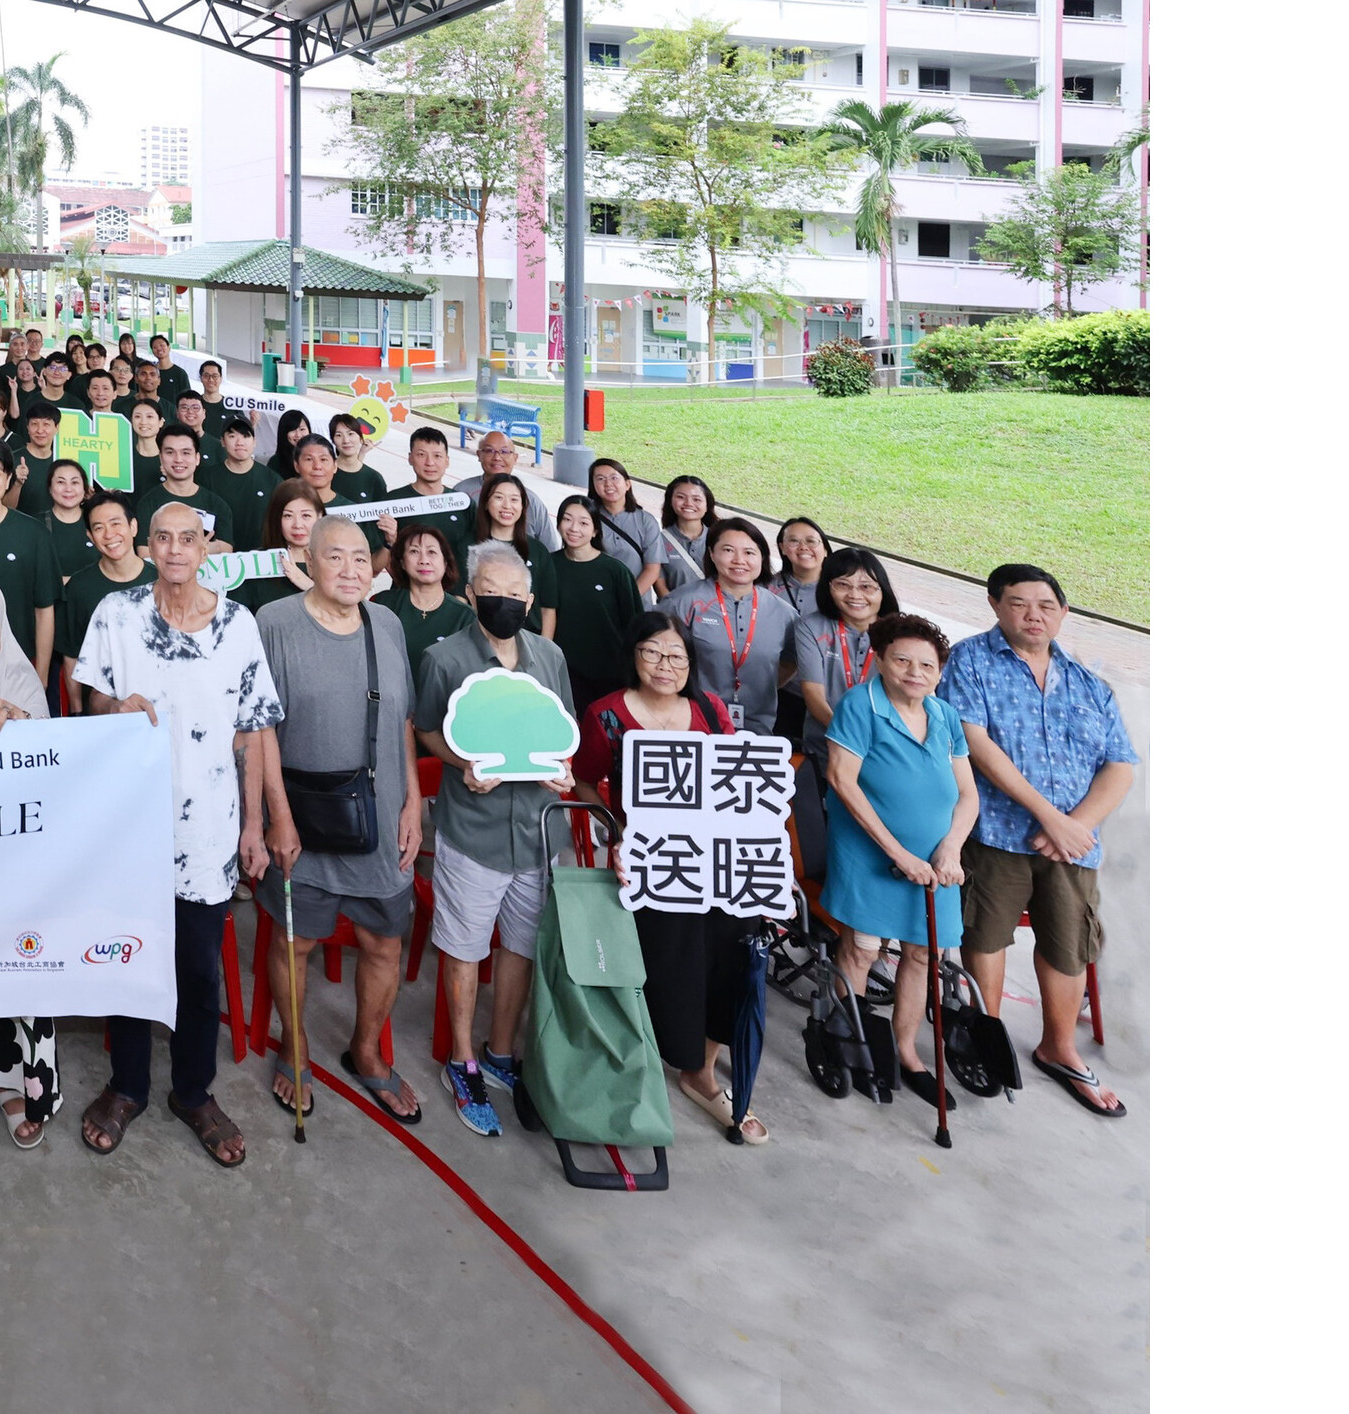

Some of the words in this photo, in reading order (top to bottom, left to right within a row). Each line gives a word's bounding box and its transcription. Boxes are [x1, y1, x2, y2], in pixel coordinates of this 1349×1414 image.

[225, 396, 244, 408] CU
[247, 398, 285, 412] Smile
[63, 437, 113, 451] HEARTY
[359, 506, 390, 518] United
[392, 504, 416, 515] Bank
[11, 748, 60, 769] Bank
[632, 740, 787, 816] 國泰
[629, 831, 787, 911] 送暖
[95, 942, 132, 964] wpg
